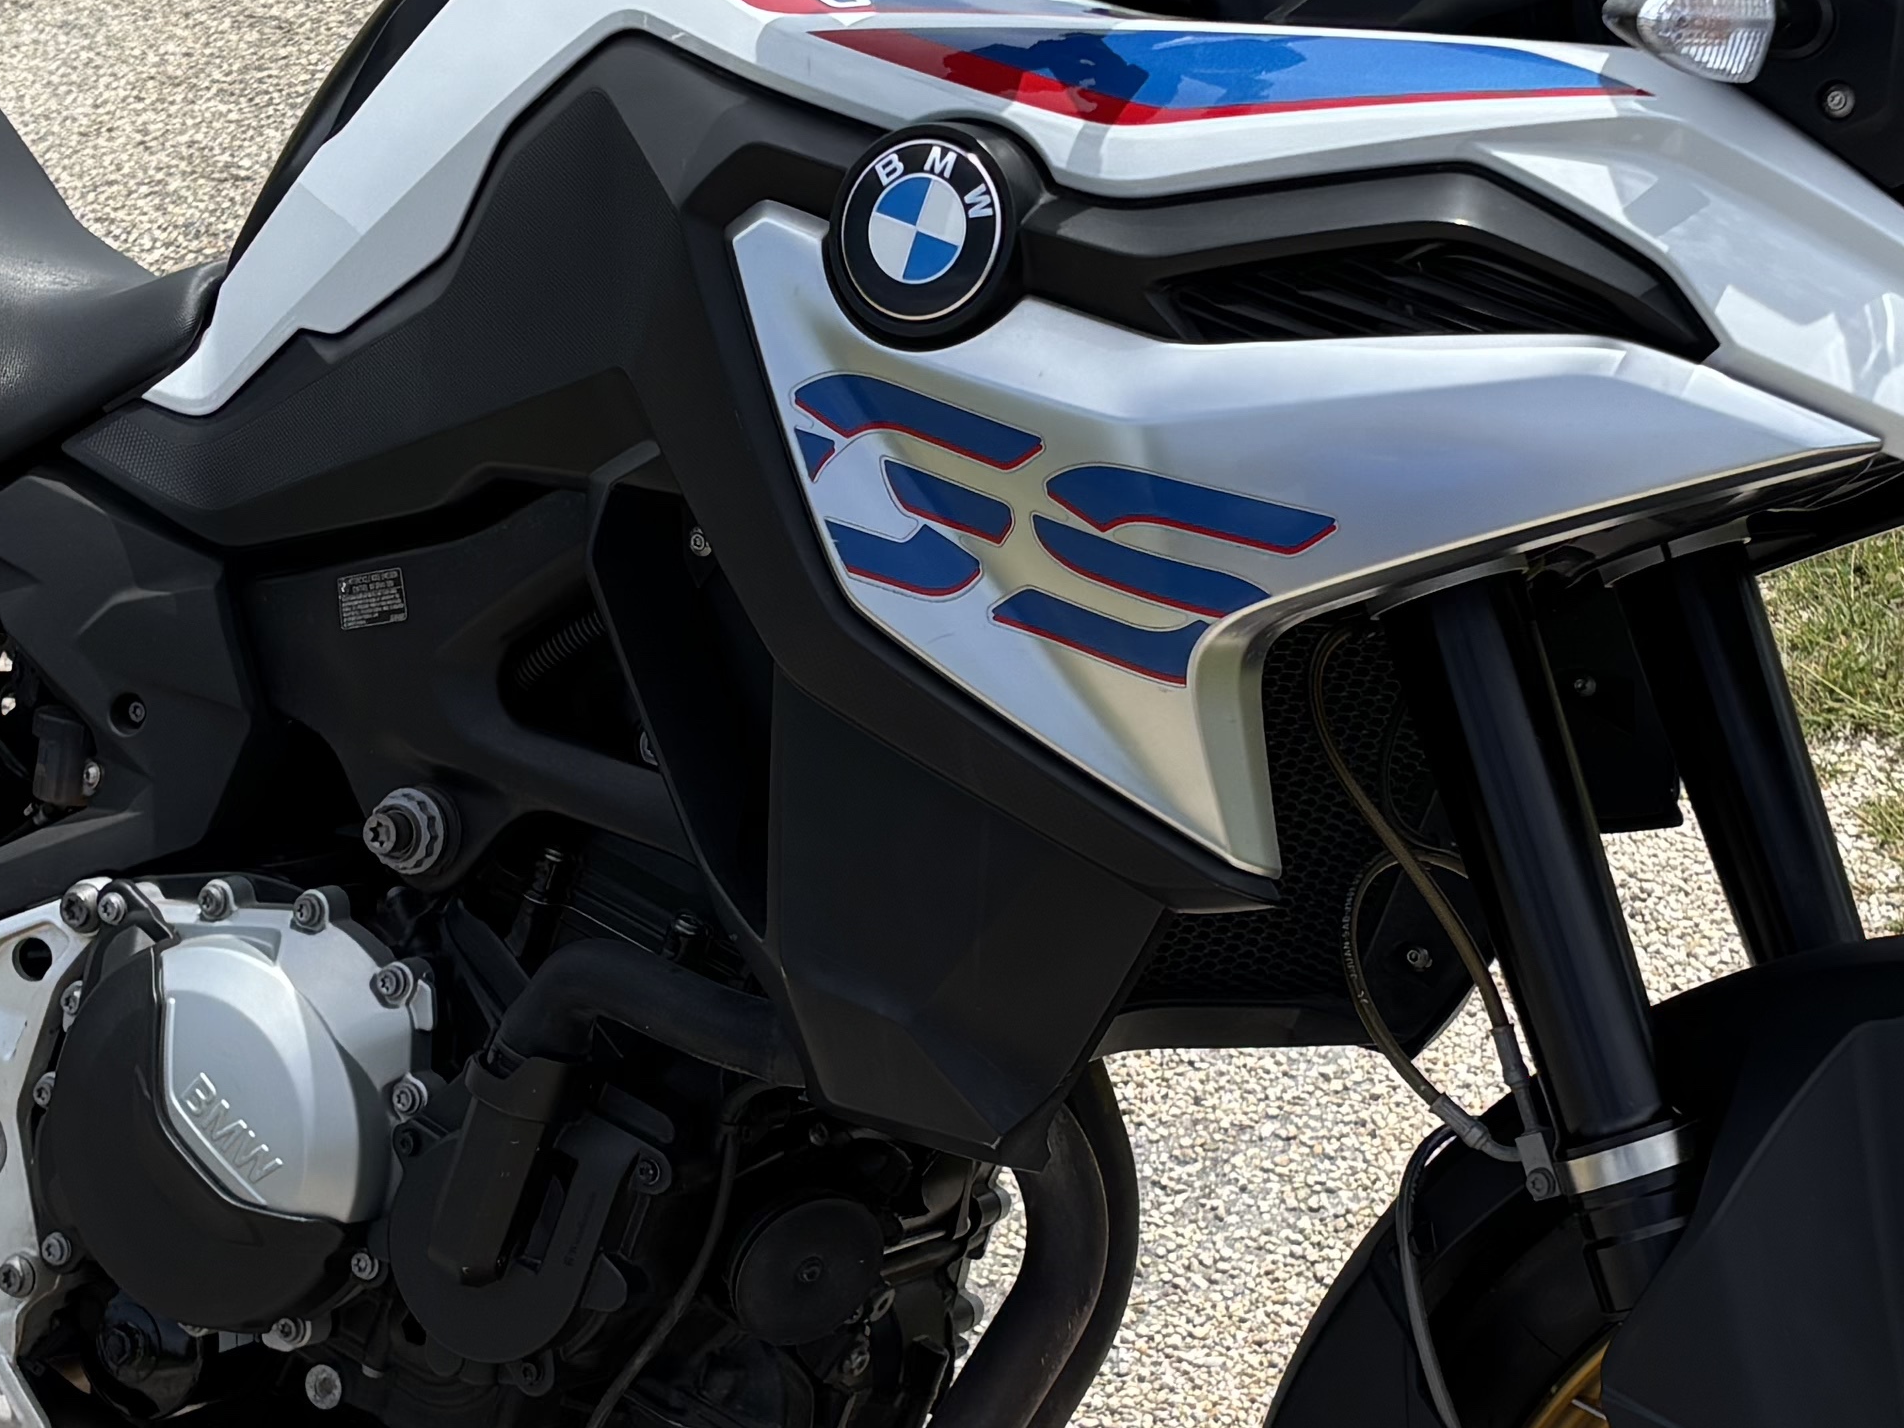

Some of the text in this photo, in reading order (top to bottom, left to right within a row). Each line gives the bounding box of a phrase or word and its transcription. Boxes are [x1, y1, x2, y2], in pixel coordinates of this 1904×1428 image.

[874, 145, 994, 220] BMW
[793, 372, 1336, 688] GS
[180, 1072, 283, 1184] BMW
